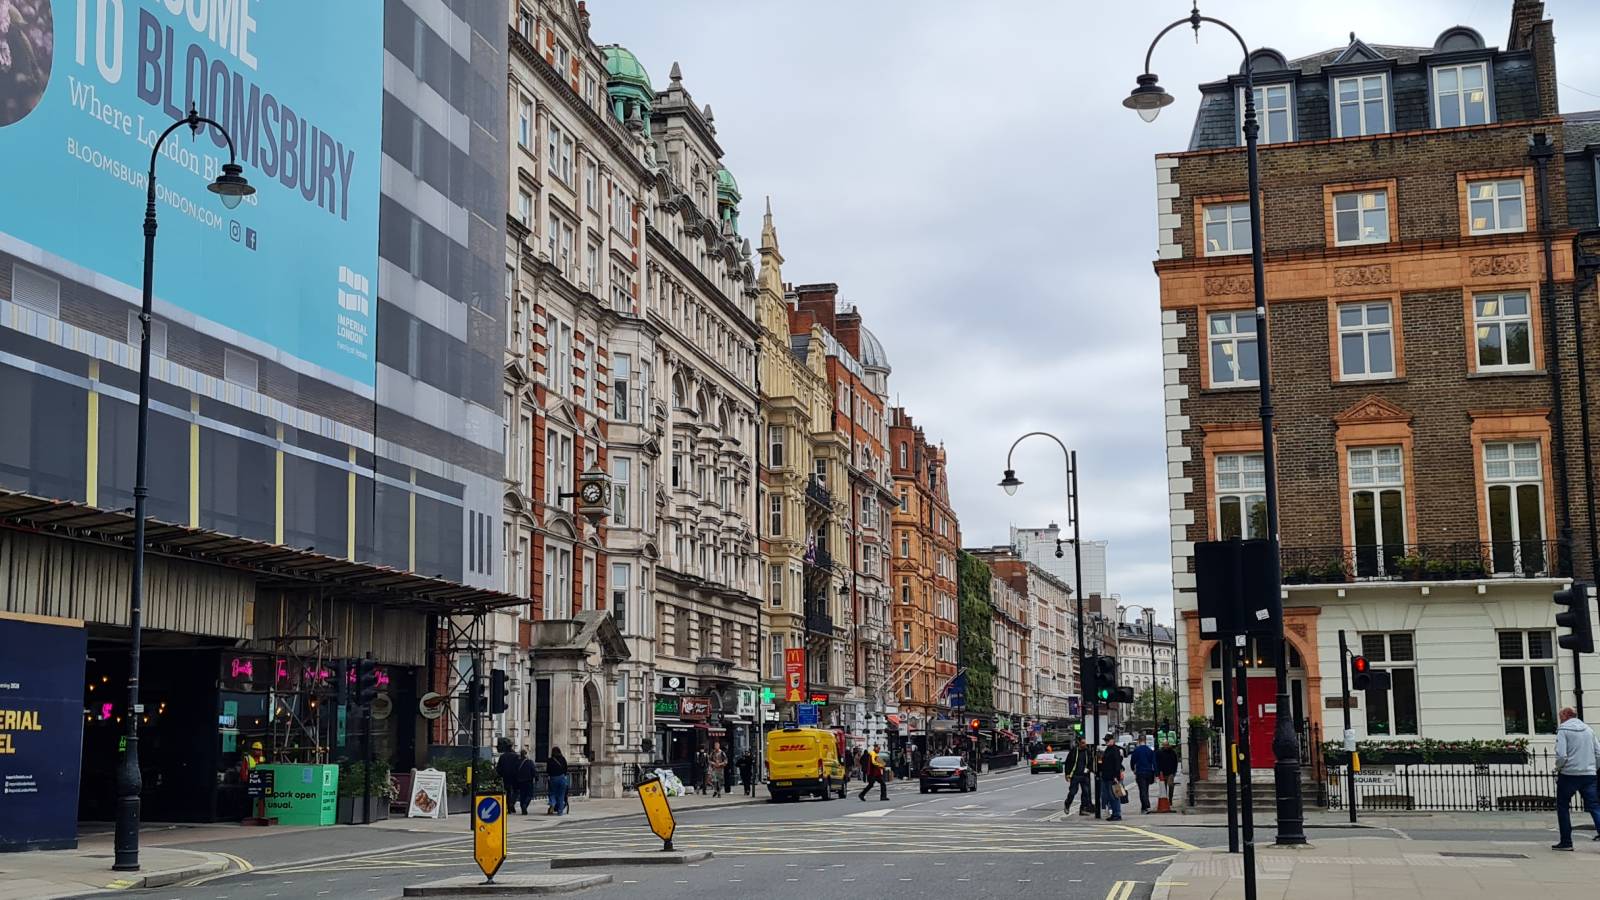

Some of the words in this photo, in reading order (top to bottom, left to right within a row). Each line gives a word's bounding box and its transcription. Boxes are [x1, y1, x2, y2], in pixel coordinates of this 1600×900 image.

[67, 75, 132, 136] Where
[136, 114, 200, 176] London
[137, 7, 355, 221] BLOOMSBURY
[67, 137, 222, 230] BLOOMSBURYONDON.COM
[337, 313, 368, 337] IMPERIAL
[337, 324, 363, 345] LONDON
[776, 744, 811, 752] DHL
[273, 791, 293, 799] park
[294, 792, 317, 800] open
